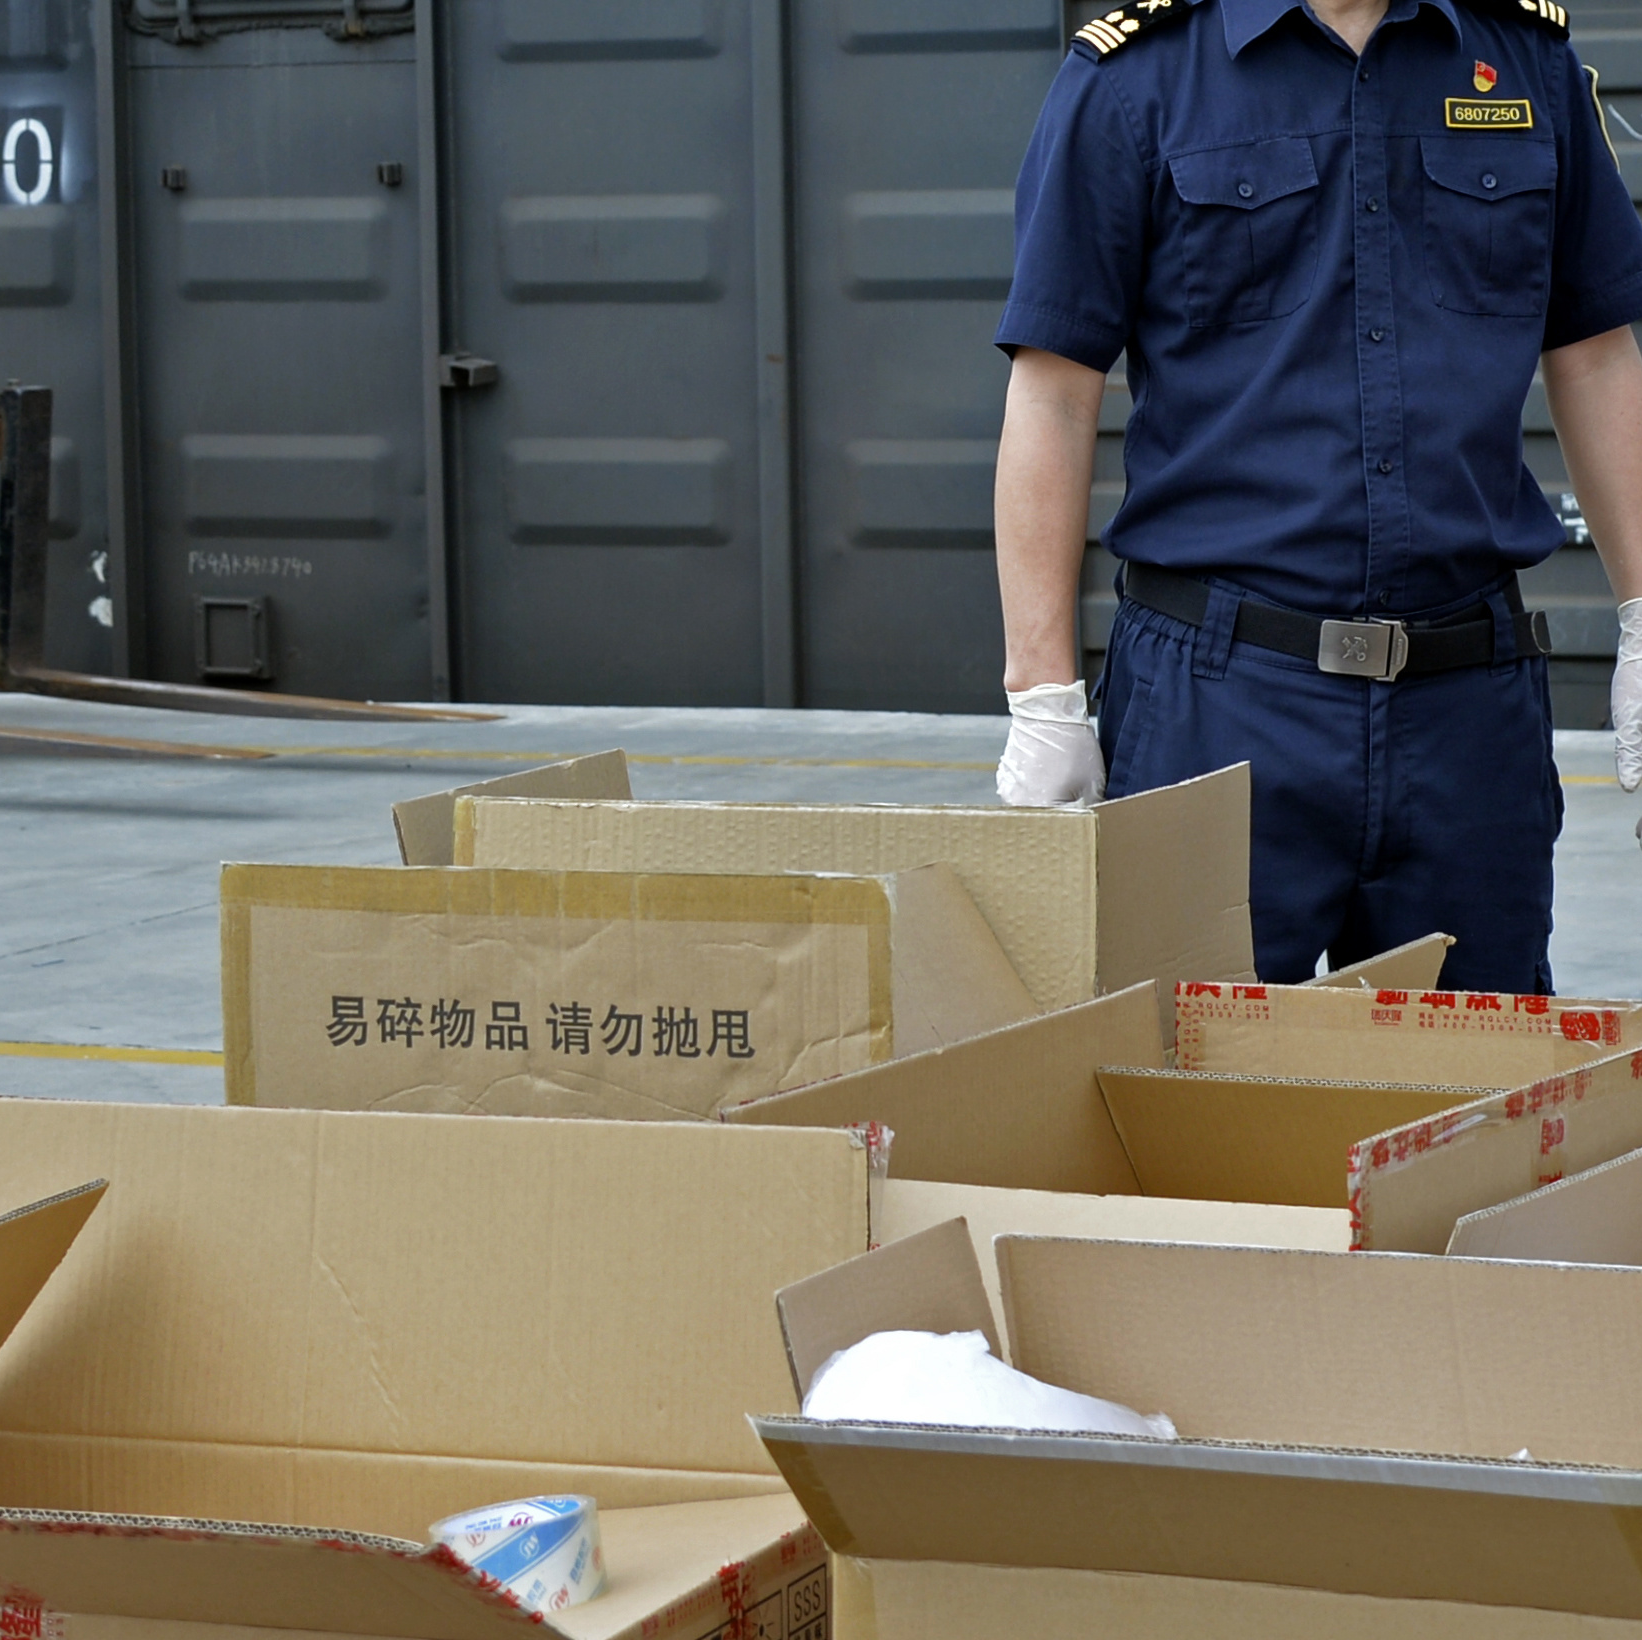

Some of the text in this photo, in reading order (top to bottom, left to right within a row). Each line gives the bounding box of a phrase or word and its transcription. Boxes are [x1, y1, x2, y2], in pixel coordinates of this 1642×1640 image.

[1454, 106, 1521, 122] 6807250
[325, 994, 756, 1059] 易碎物品 请勿抛甩
[793, 1580, 822, 1622] SSS
